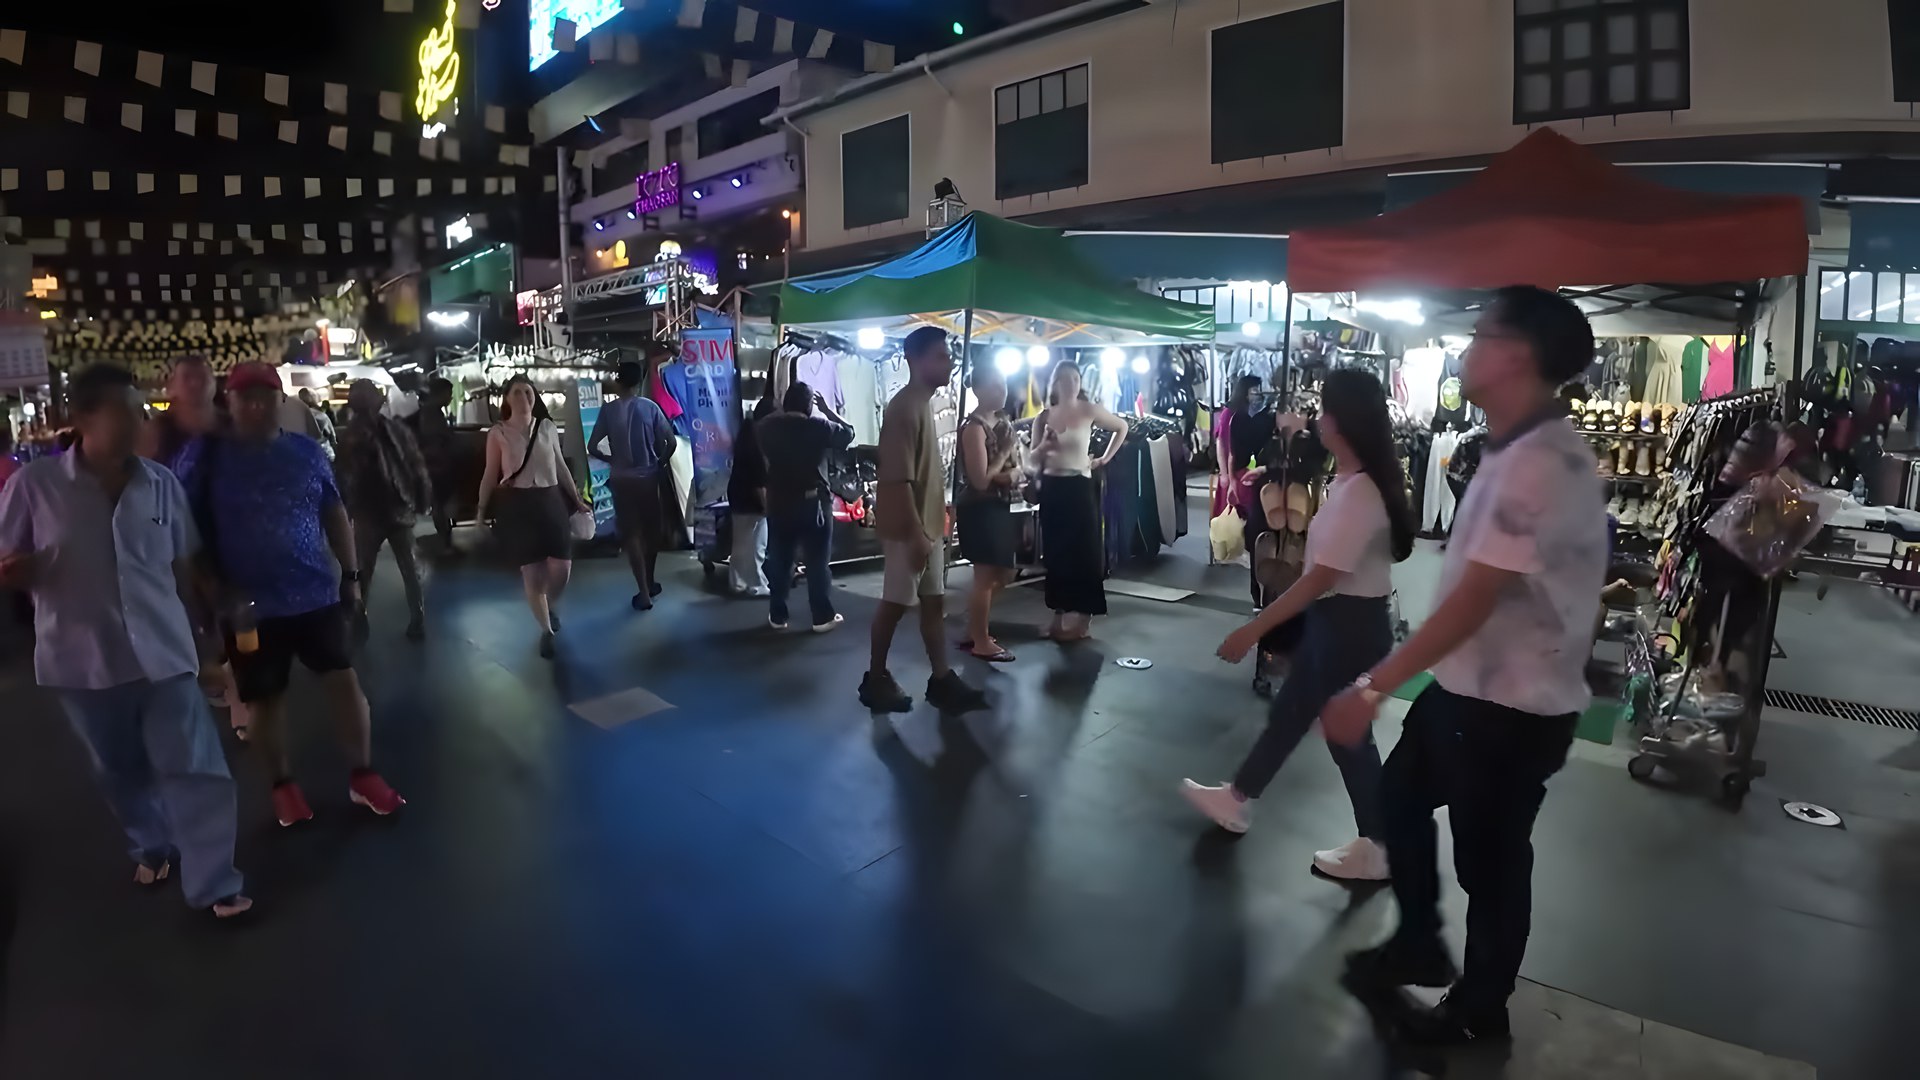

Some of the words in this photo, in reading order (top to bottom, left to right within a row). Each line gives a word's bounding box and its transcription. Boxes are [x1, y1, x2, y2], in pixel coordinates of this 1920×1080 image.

[682, 339, 733, 363] SIM
[684, 364, 725, 378] CARD
[578, 386, 597, 399] SIM
